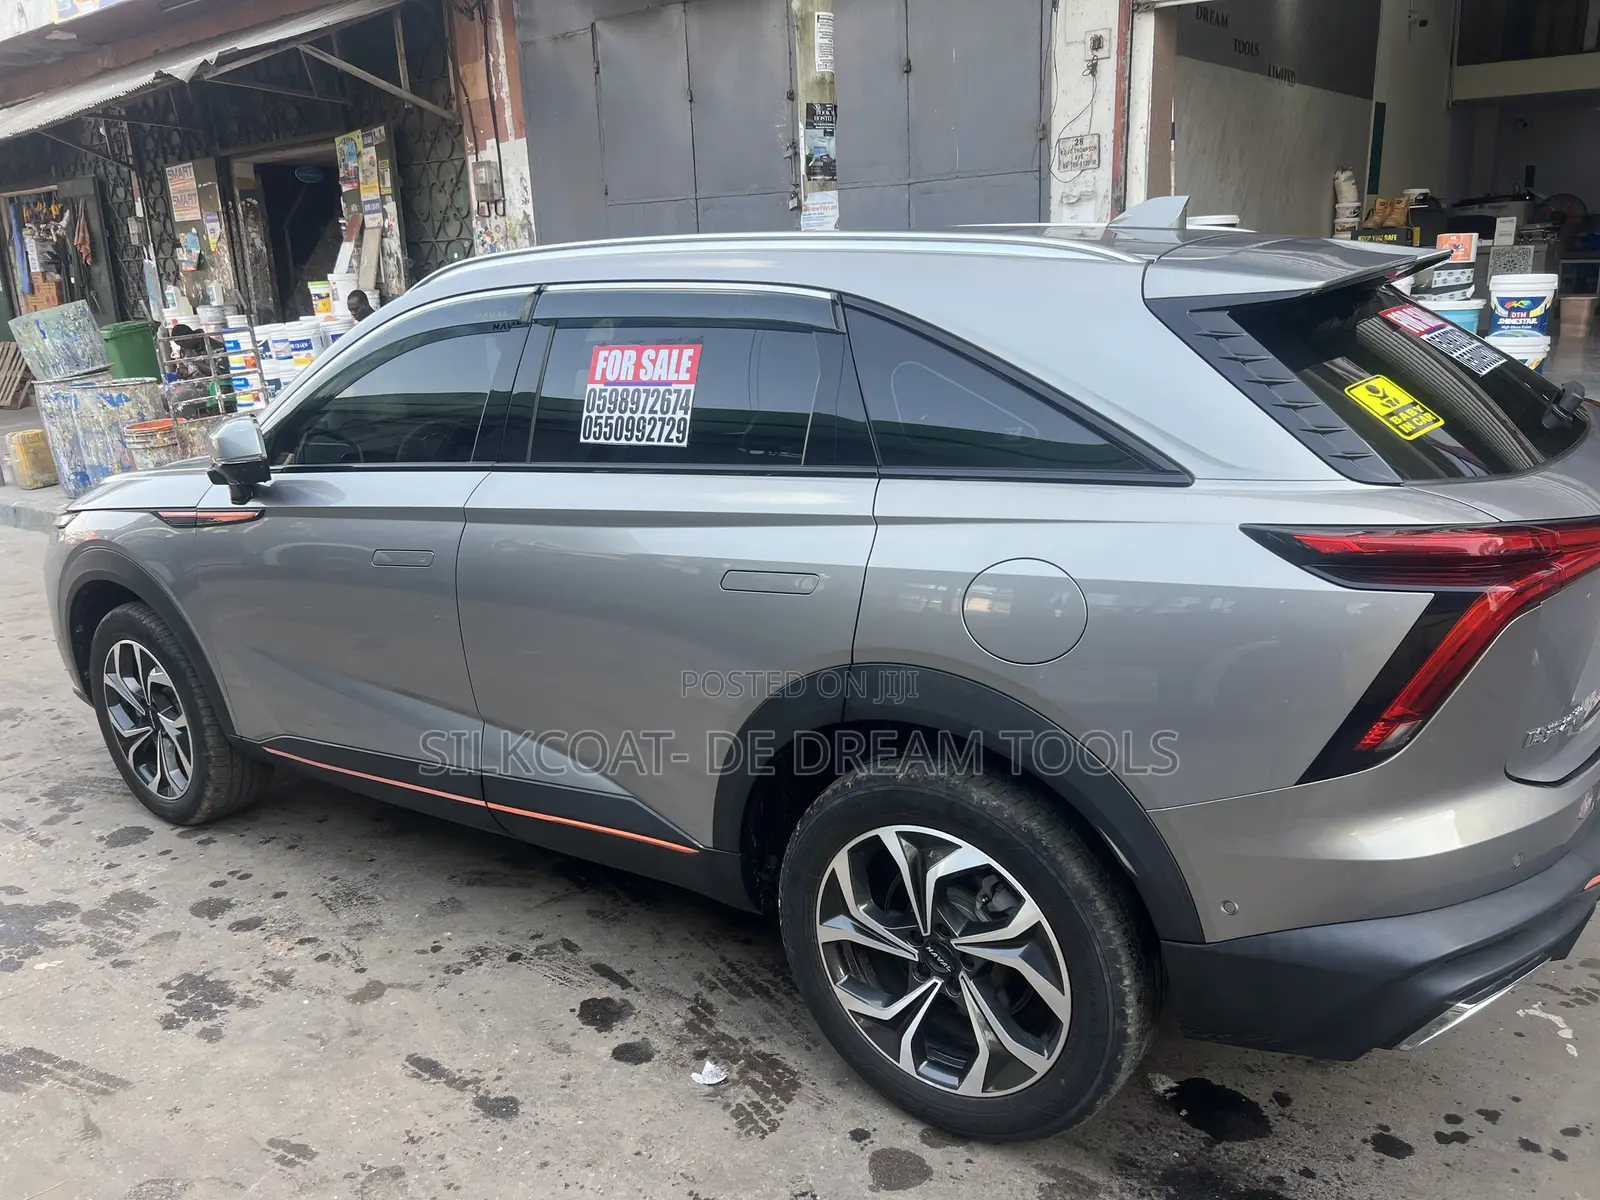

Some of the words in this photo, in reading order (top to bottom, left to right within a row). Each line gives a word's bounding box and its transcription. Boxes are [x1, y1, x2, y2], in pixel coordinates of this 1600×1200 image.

[1196, 5, 1228, 28] DREAM
[1233, 37, 1260, 57] TOOLS
[1074, 138, 1084, 146] 28
[595, 349, 637, 382] FOR
[639, 348, 695, 381] SALE
[586, 387, 692, 415] 0598972674
[1389, 404, 1424, 425] BABY
[1398, 421, 1417, 433] IN
[1412, 412, 1437, 426] CAR
[582, 415, 688, 443] 0550992729
[926, 945, 952, 972] HAVAL
